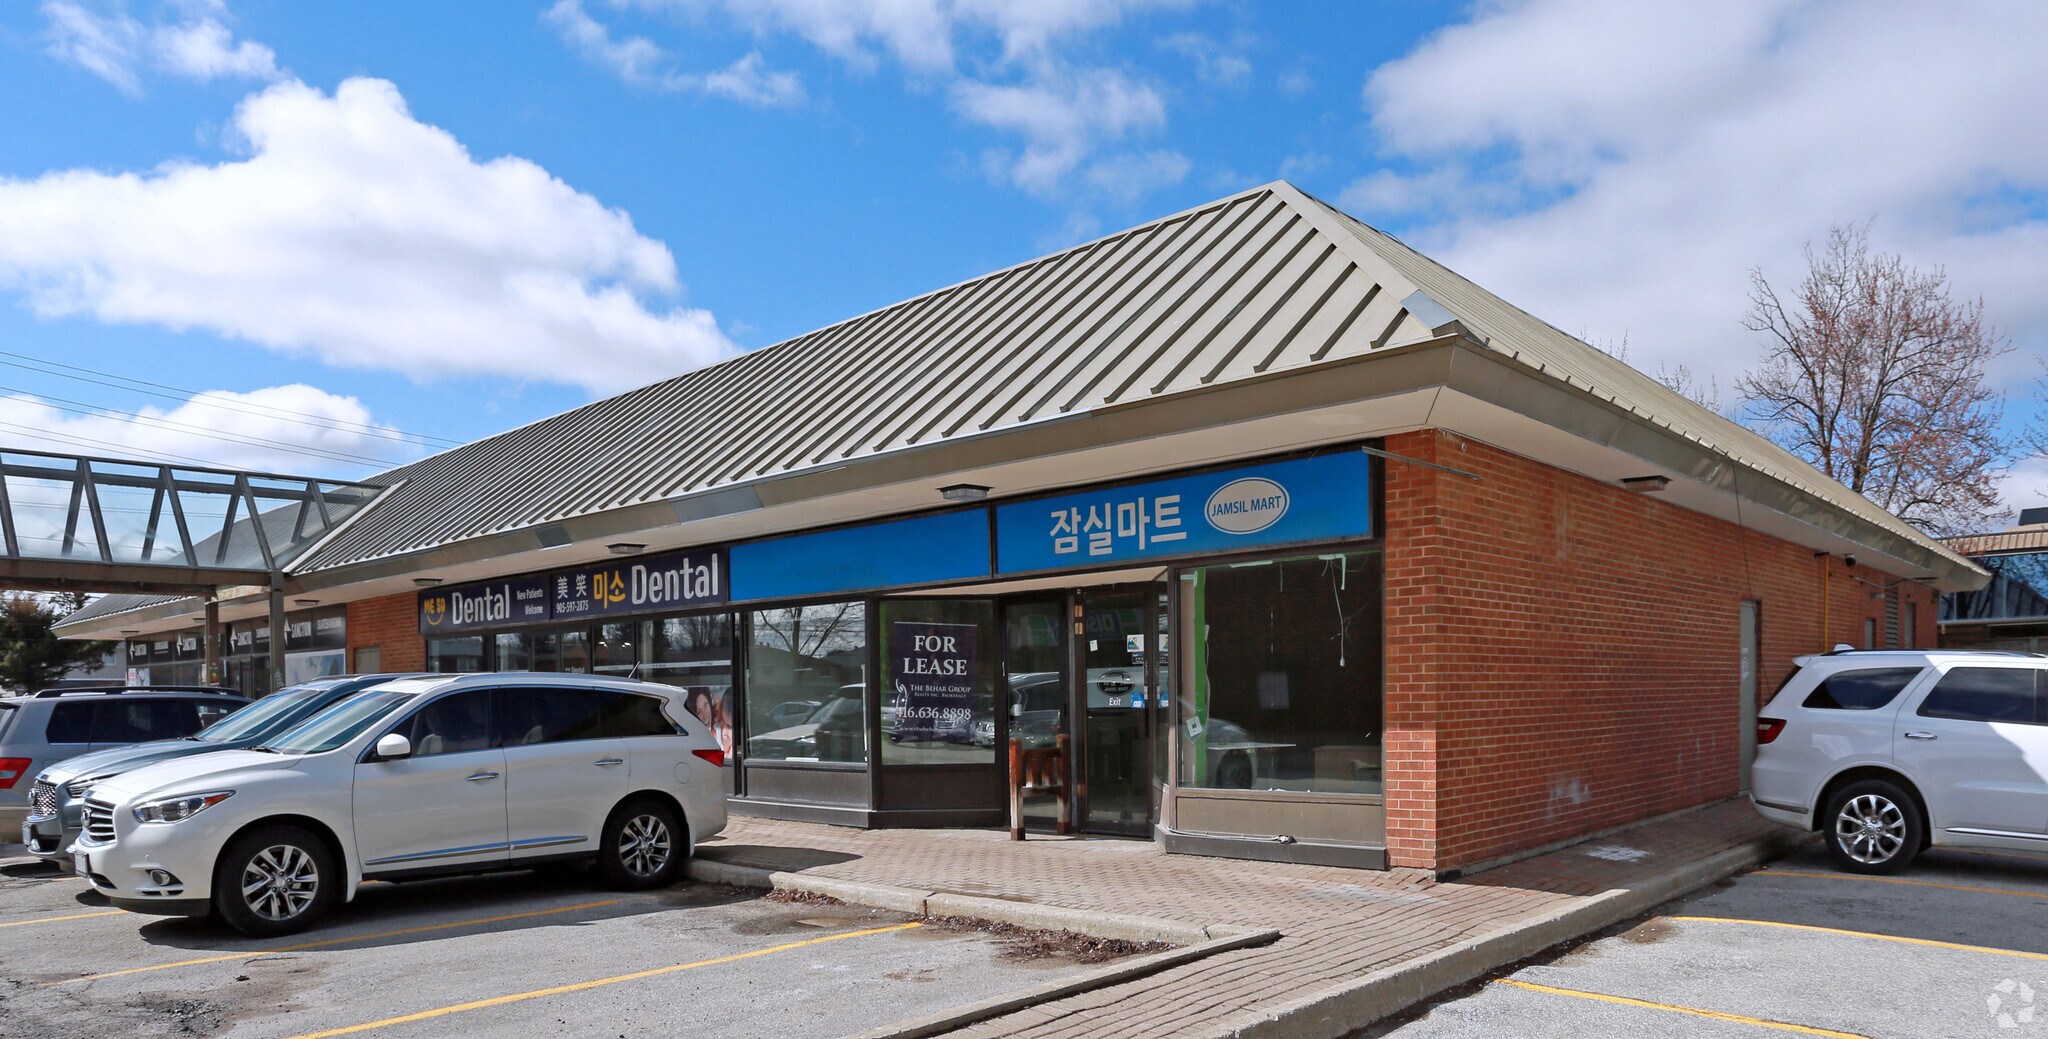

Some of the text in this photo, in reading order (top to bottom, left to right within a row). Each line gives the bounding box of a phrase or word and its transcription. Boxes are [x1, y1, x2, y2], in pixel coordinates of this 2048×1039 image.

[1211, 495, 1281, 517] JAMSIL MART
[1049, 494, 1187, 556] 잠실마트
[631, 553, 718, 605] Dental
[516, 588, 544, 601] New Patients
[593, 570, 626, 609] 미소
[423, 598, 435, 614] ME
[452, 584, 510, 625] Dental
[524, 604, 544, 615] Welcome
[556, 600, 589, 613] 905-597-2875
[914, 635, 957, 653] FOR
[903, 657, 967, 676] LEASE
[910, 684, 972, 693] THE BEHAR GROUP
[1109, 697, 1122, 706] Exit
[895, 706, 971, 720] 416.636.8898
